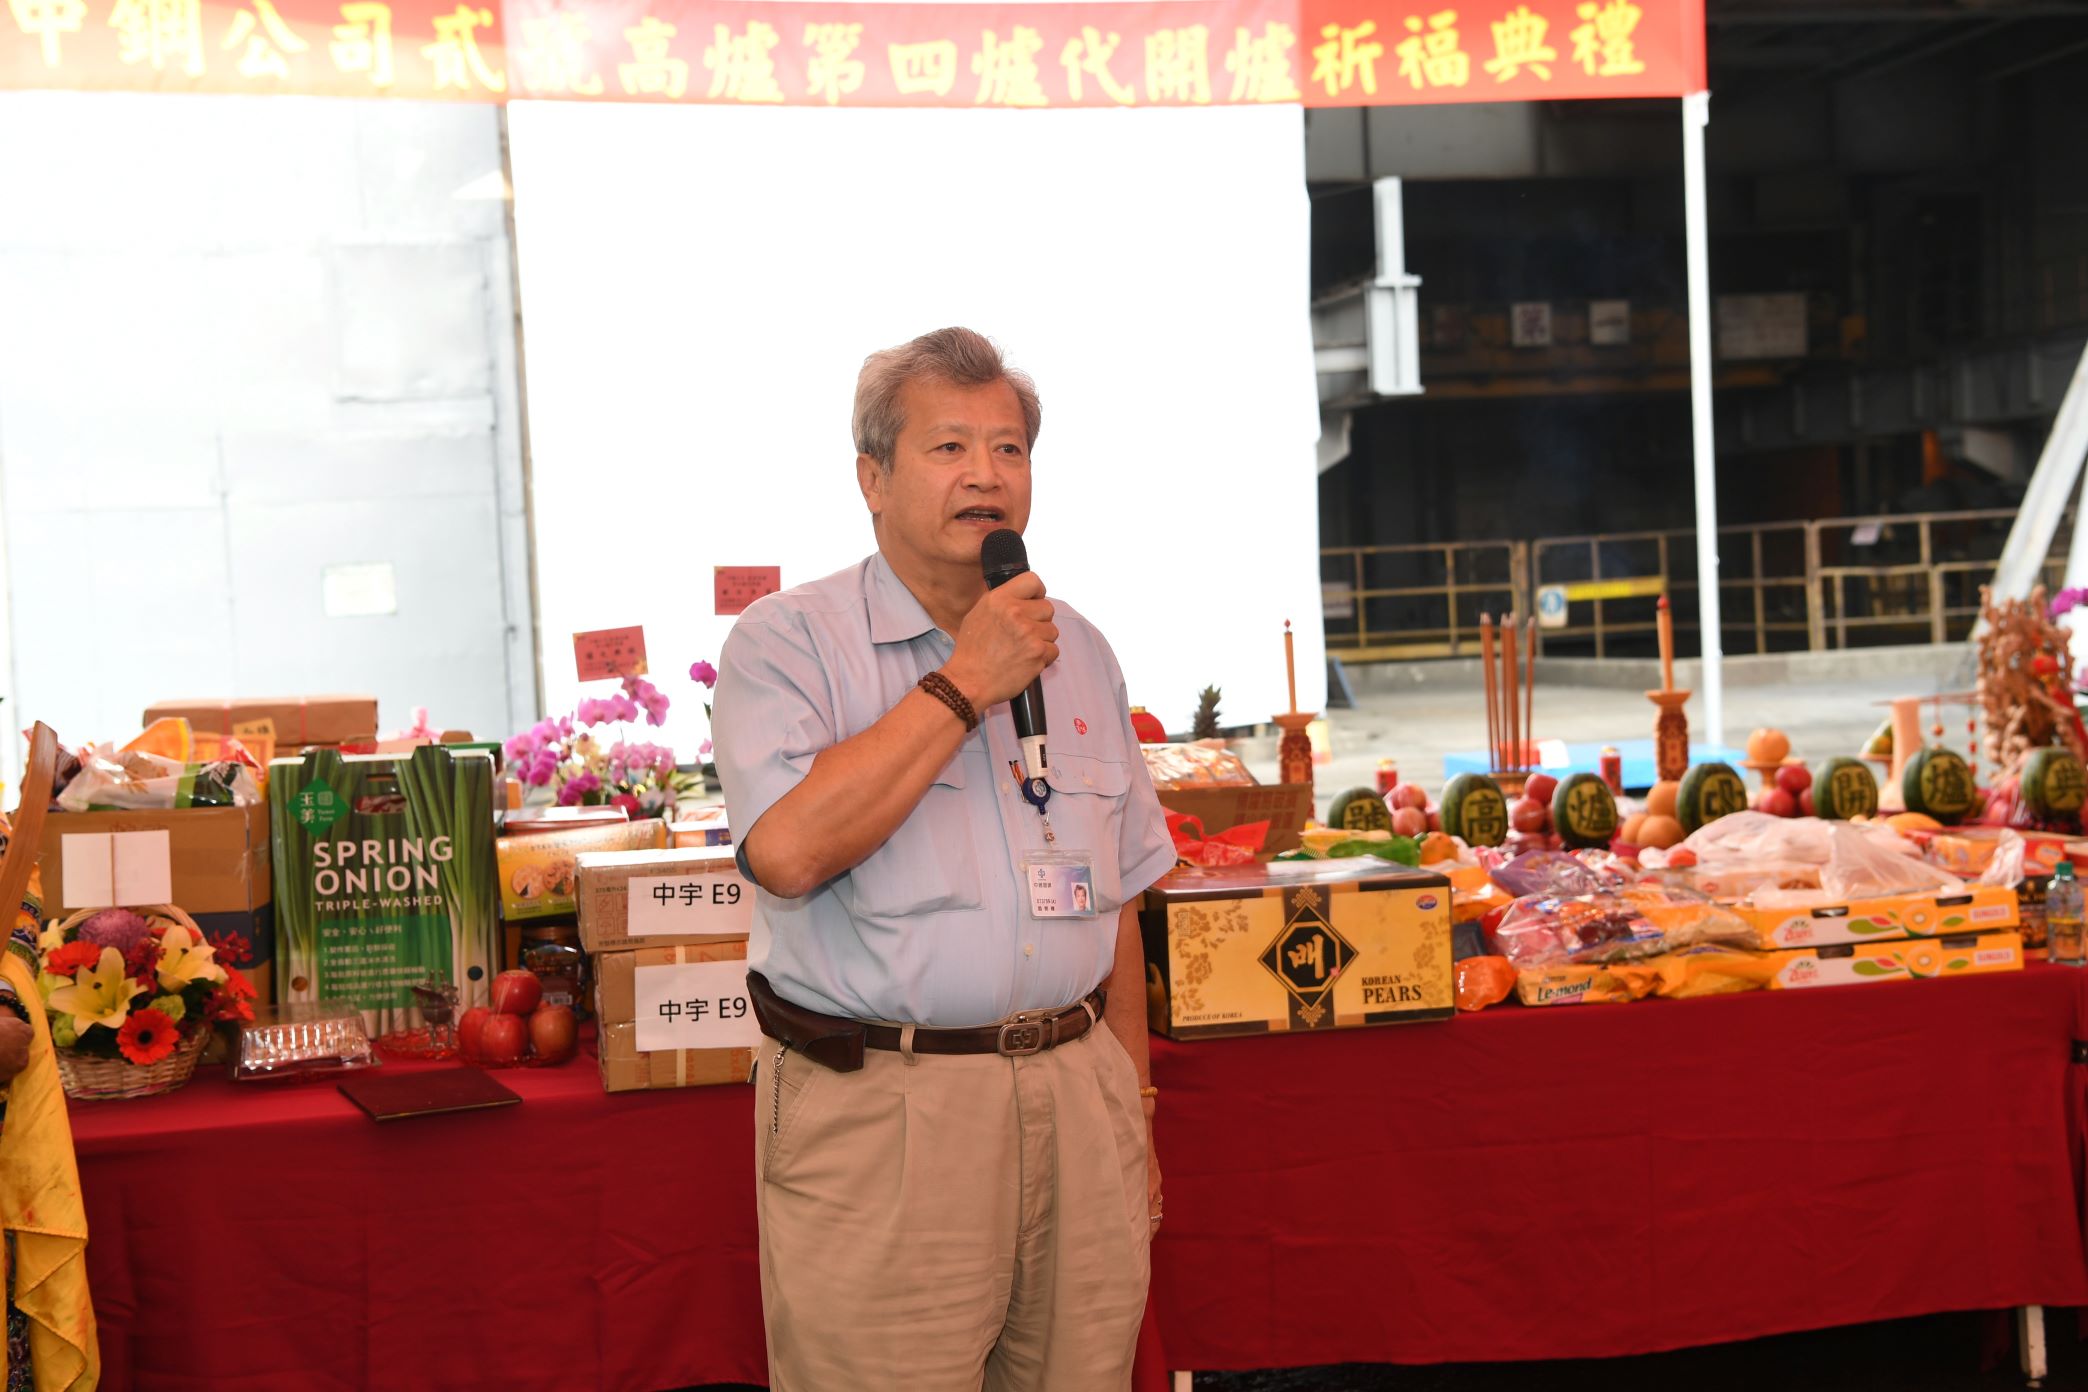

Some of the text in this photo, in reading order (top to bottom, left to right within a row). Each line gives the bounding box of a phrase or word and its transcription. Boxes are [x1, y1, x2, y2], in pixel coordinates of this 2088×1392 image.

[1836, 767, 1871, 818] 開
[1467, 795, 1501, 841] 高
[313, 835, 453, 868] SPRING
[314, 864, 440, 895] ONION
[315, 895, 443, 912] TRIPLE-WASHED
[652, 882, 741, 906] 中宇 E9
[1361, 974, 1402, 987] KOREAN
[1362, 984, 1422, 1005] PEARS
[659, 997, 747, 1023] 中宇 E9
